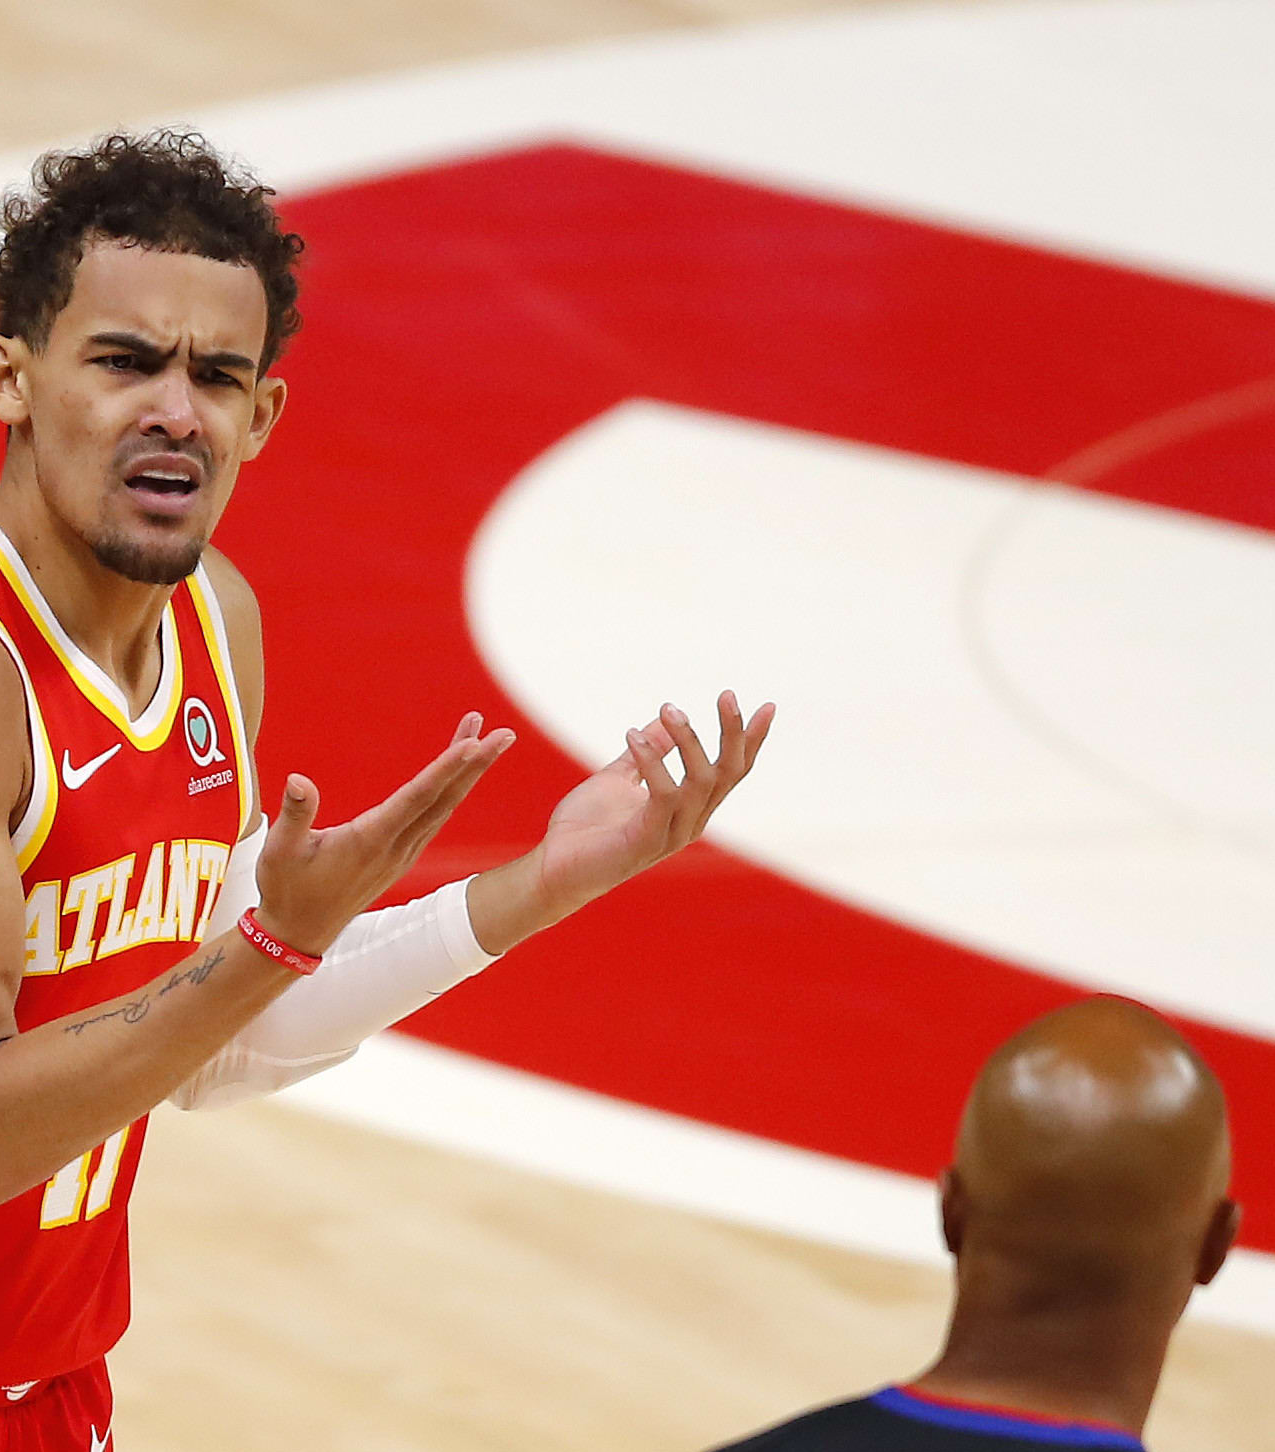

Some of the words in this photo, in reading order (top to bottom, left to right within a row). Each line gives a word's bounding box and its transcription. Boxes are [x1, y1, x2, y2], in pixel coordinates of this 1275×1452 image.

[187, 769, 234, 796] sharecare
[22, 838, 232, 977] ATLANT
[253, 931, 284, 957] 5106
